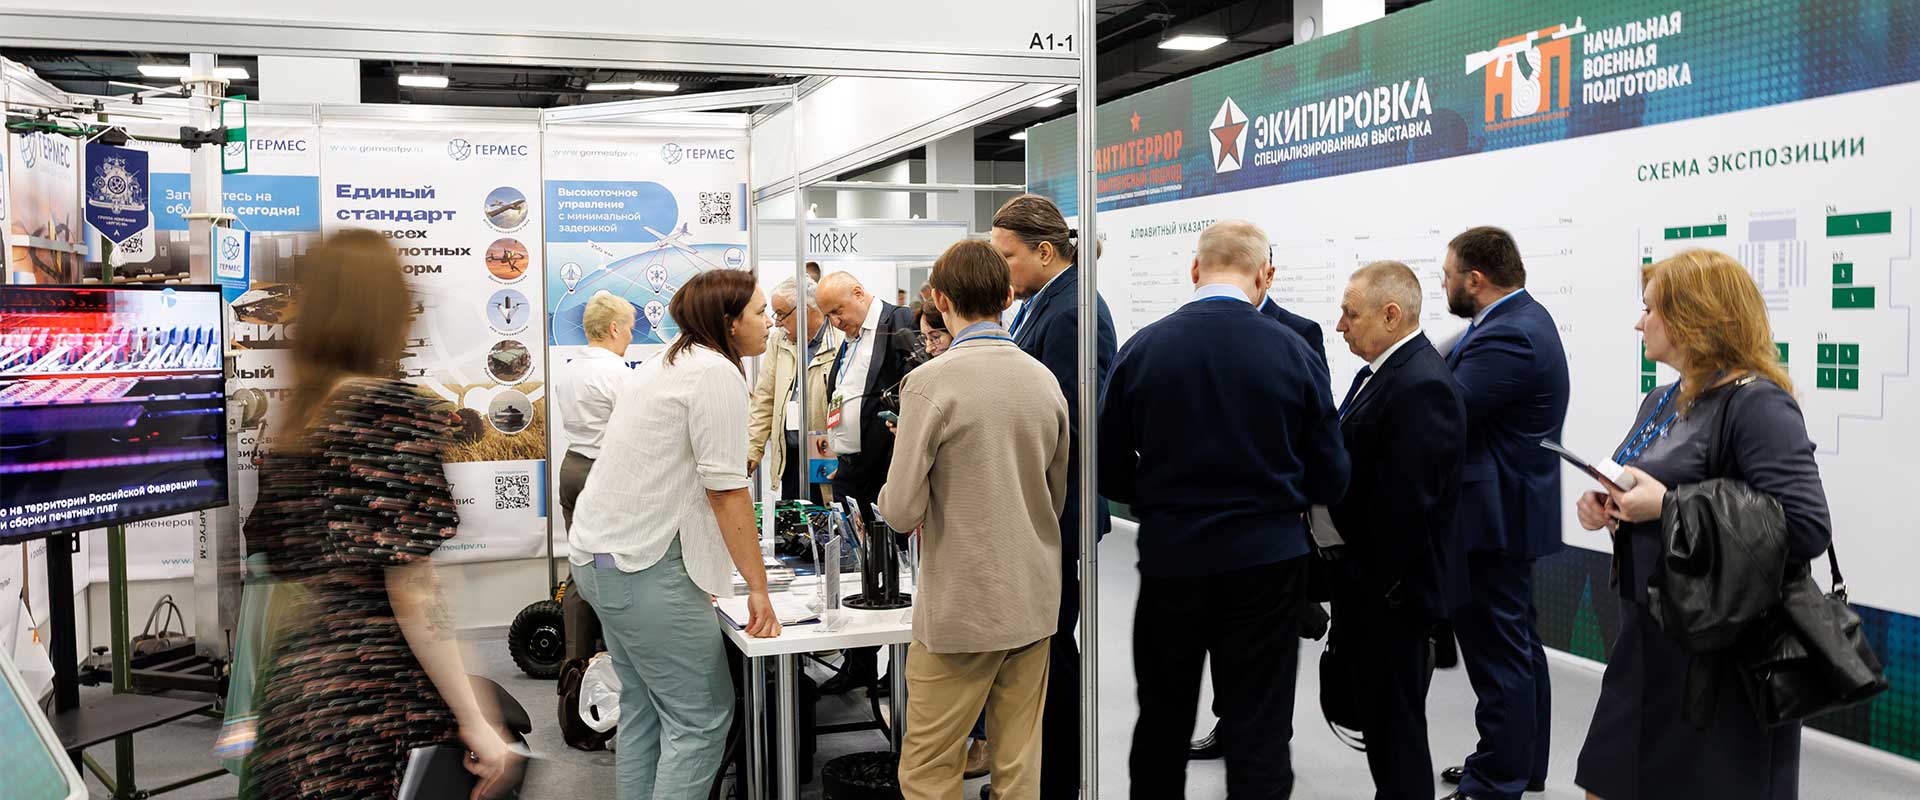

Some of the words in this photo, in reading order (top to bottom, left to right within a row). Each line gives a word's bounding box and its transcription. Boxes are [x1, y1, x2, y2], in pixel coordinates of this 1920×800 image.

[1583, 11, 1682, 55] НАЧАЛЬНАЯ
[1029, 33, 1073, 51] A1-1
[1583, 44, 1658, 80] ВОЕННАЯ
[1583, 62, 1692, 104] ПОДГОТОВКА
[1254, 77, 1433, 149] ЭКИПИРОВКА
[249, 139, 307, 152] ГЕРМЕС
[475, 144, 528, 156] ГЕРМЕС
[1096, 130, 1183, 173] АНТИТЕРРОР
[1254, 132, 1369, 167] СПЕЦИАЛИЗИРОВАННАЯ
[1371, 119, 1433, 145] ВЫСТАВКА
[686, 148, 736, 160] ГЕРМЕС
[1637, 159, 1700, 182] СХЕМА
[1708, 136, 1865, 174] ЭКСПОЗИЦИИ
[255, 192, 272, 201] на
[336, 184, 435, 200] Единый
[558, 187, 639, 198] Высокоточное
[238, 205, 300, 217] сегодня!
[558, 200, 625, 211] управление
[336, 209, 457, 224] стандарт
[558, 213, 565, 221] с
[567, 211, 641, 221] минимальной
[558, 223, 618, 235] задержкой
[1130, 221, 1177, 239] АЛФАВИТНЫЙ
[10, 506, 23, 517] на
[25, 495, 87, 515] территории
[89, 485, 145, 504] Российской
[147, 479, 198, 494] Федерации
[9, 514, 47, 529] сборки
[49, 508, 95, 522] печатных
[97, 502, 118, 514] плат
